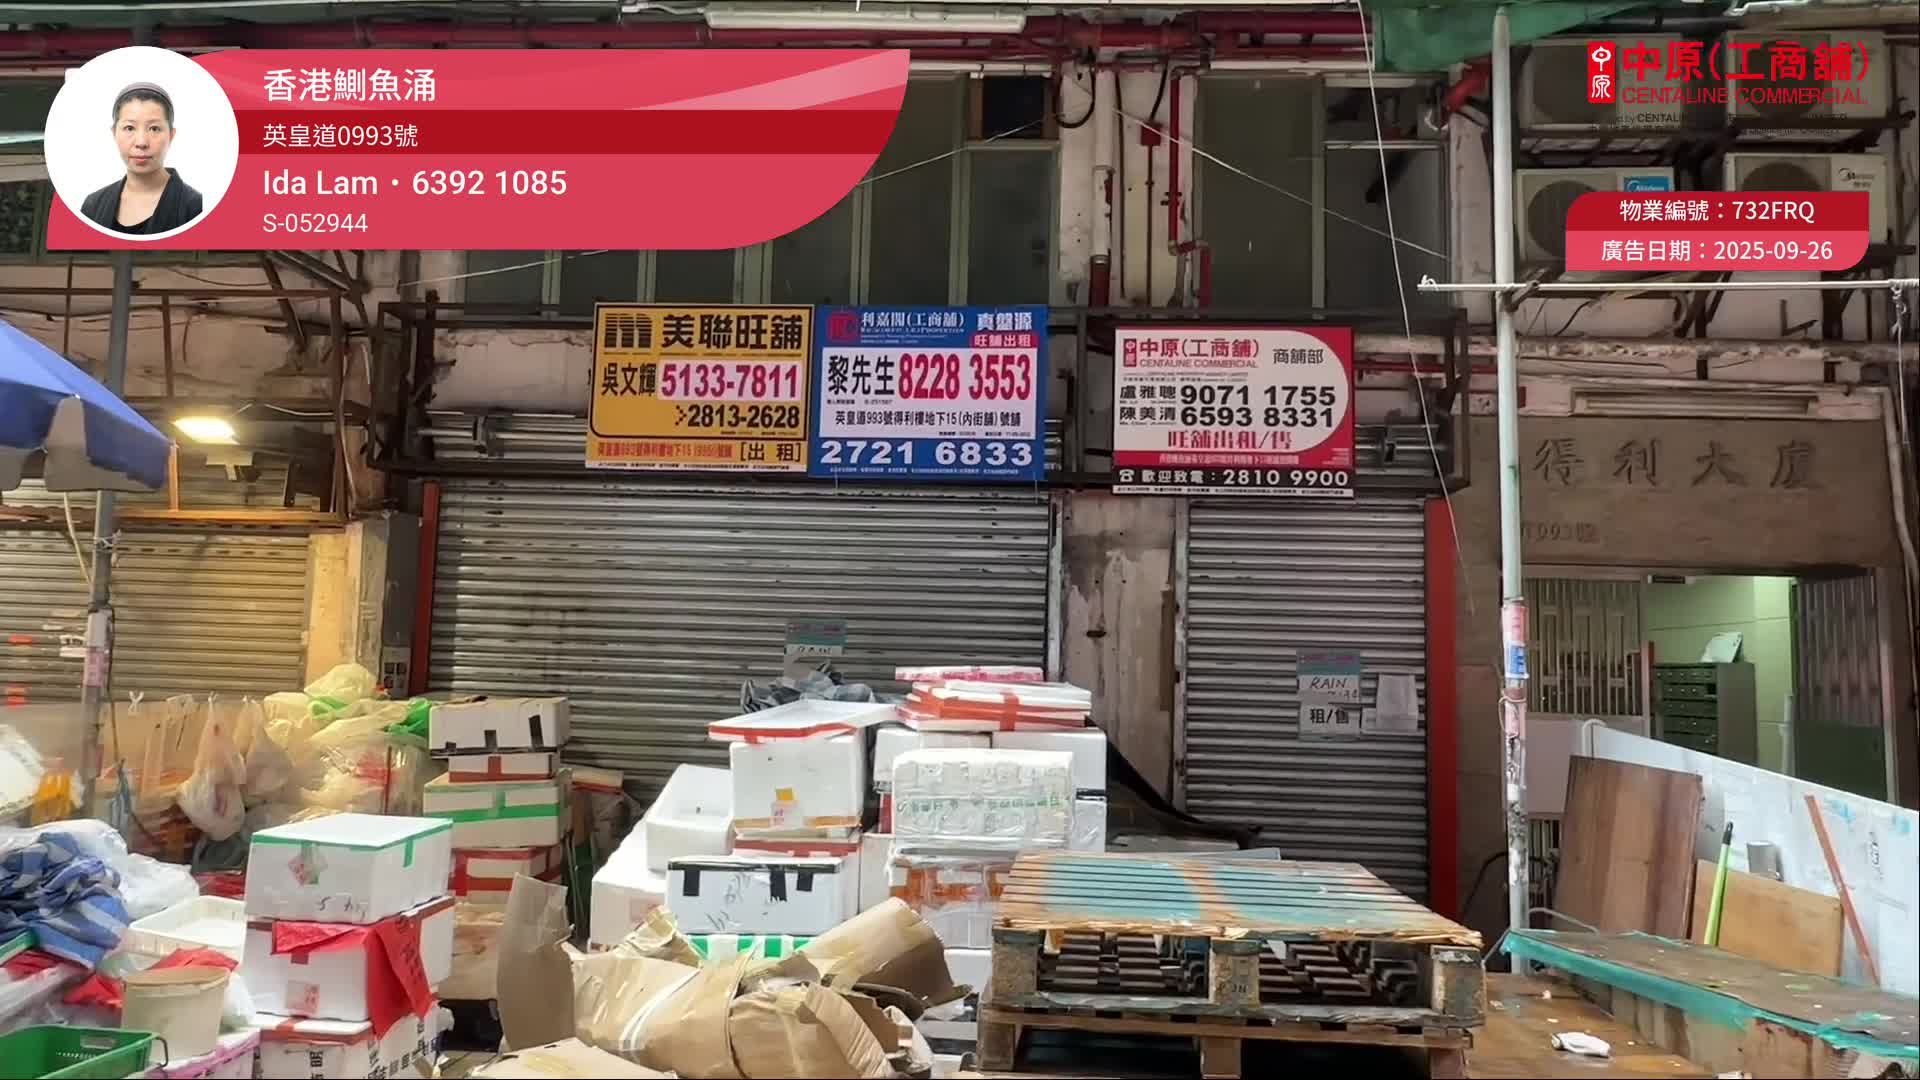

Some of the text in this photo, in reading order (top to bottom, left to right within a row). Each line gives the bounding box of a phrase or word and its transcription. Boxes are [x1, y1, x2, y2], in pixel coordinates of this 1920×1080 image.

[661, 313, 803, 350] 美聯旺舖
[973, 333, 1033, 348] 旺舖出租
[1139, 359, 1258, 369] CENTALINE COMMERCIAL
[1272, 347, 1324, 364] 商舖部
[601, 362, 798, 398] 吳文輝 5133-7811
[827, 352, 1032, 401] 黎先生 8228 3553
[1180, 385, 1252, 405] 9071
[1263, 385, 1336, 406] 1755
[687, 404, 801, 429] 2813-2628
[1119, 406, 1335, 428] 陳美清 6593 8331
[820, 440, 1033, 467] 2721 6833
[1222, 469, 1281, 486] 2810
[1289, 470, 1349, 487] 9900
[1310, 676, 1347, 690] RAIN
